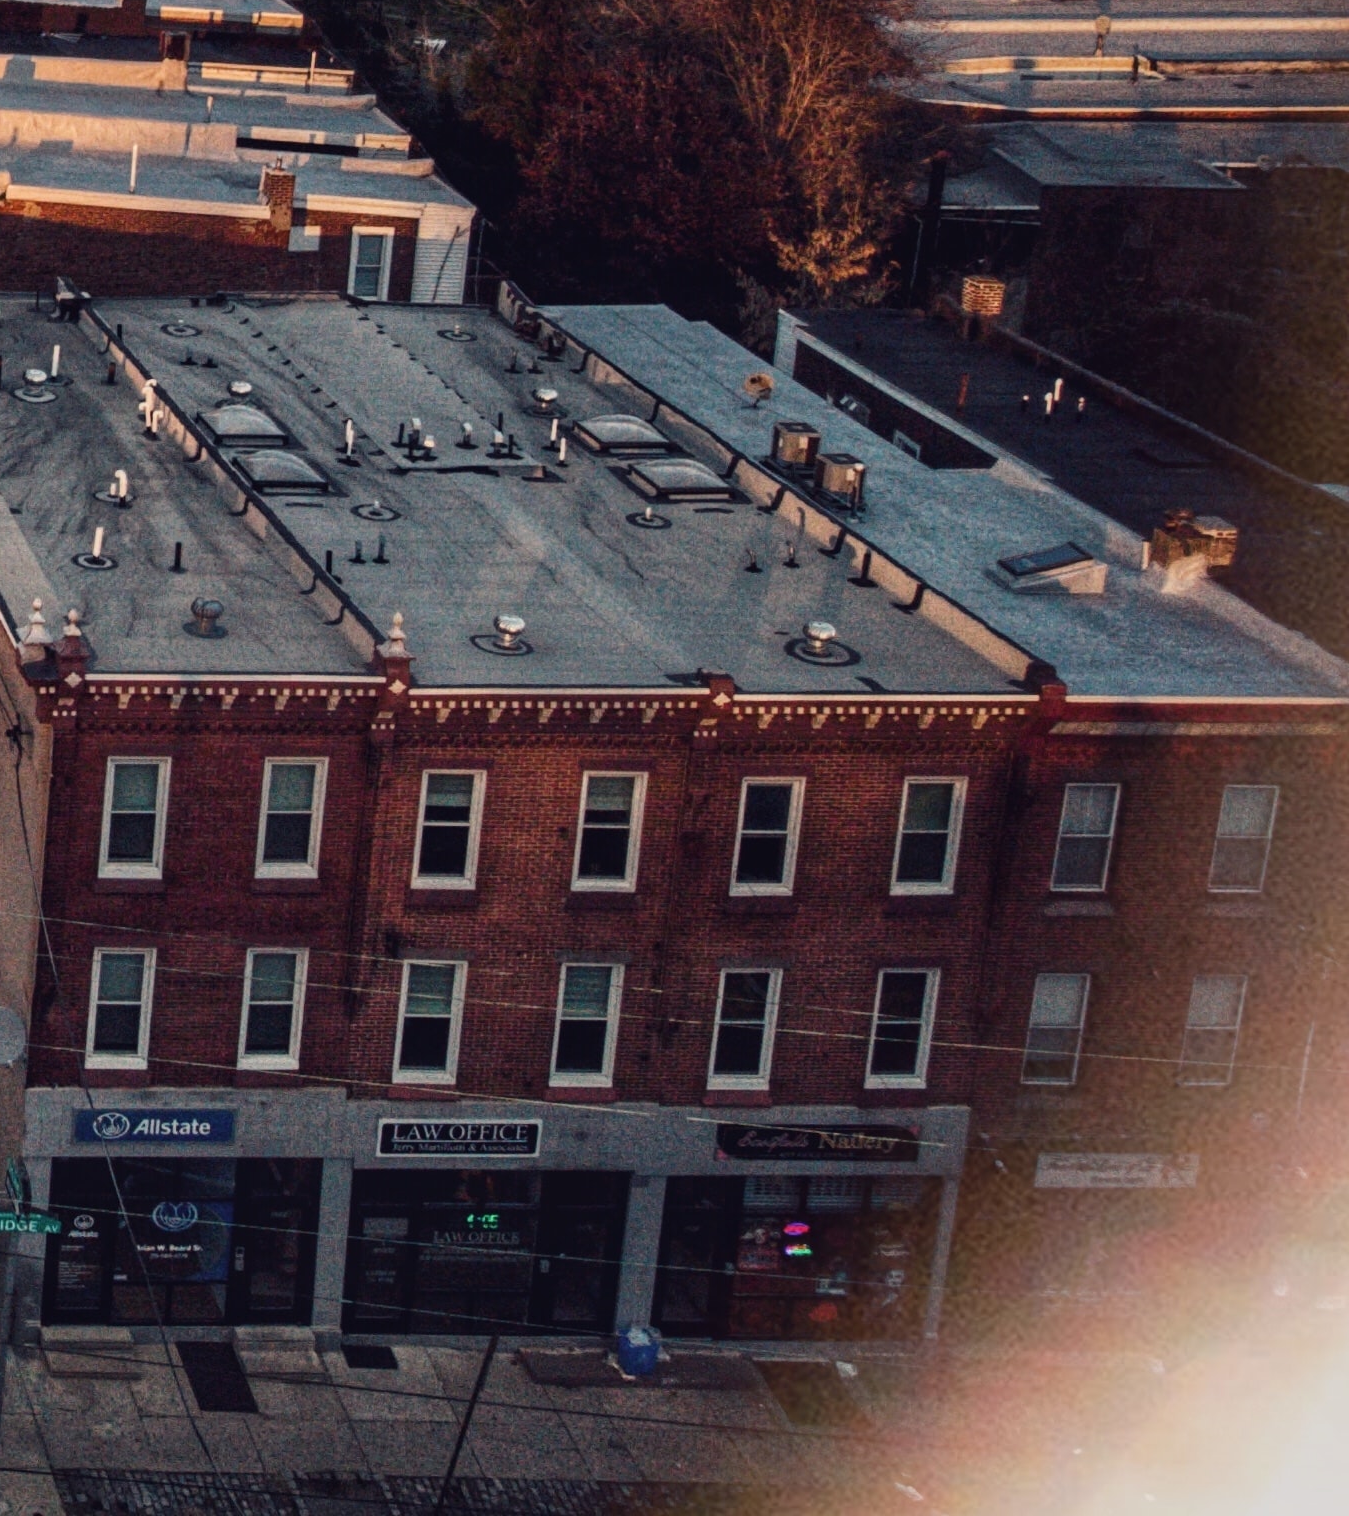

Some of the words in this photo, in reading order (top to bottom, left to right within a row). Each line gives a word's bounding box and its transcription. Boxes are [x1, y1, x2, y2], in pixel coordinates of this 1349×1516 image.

[132, 1118, 212, 1136] Allstate
[392, 1124, 445, 1140] LAW
[448, 1124, 529, 1140] OFFICE
[467, 1143, 477, 1152] &
[44, 1224, 59, 1234] AV
[432, 1230, 464, 1244] LAW
[467, 1230, 521, 1245] OFFICE
